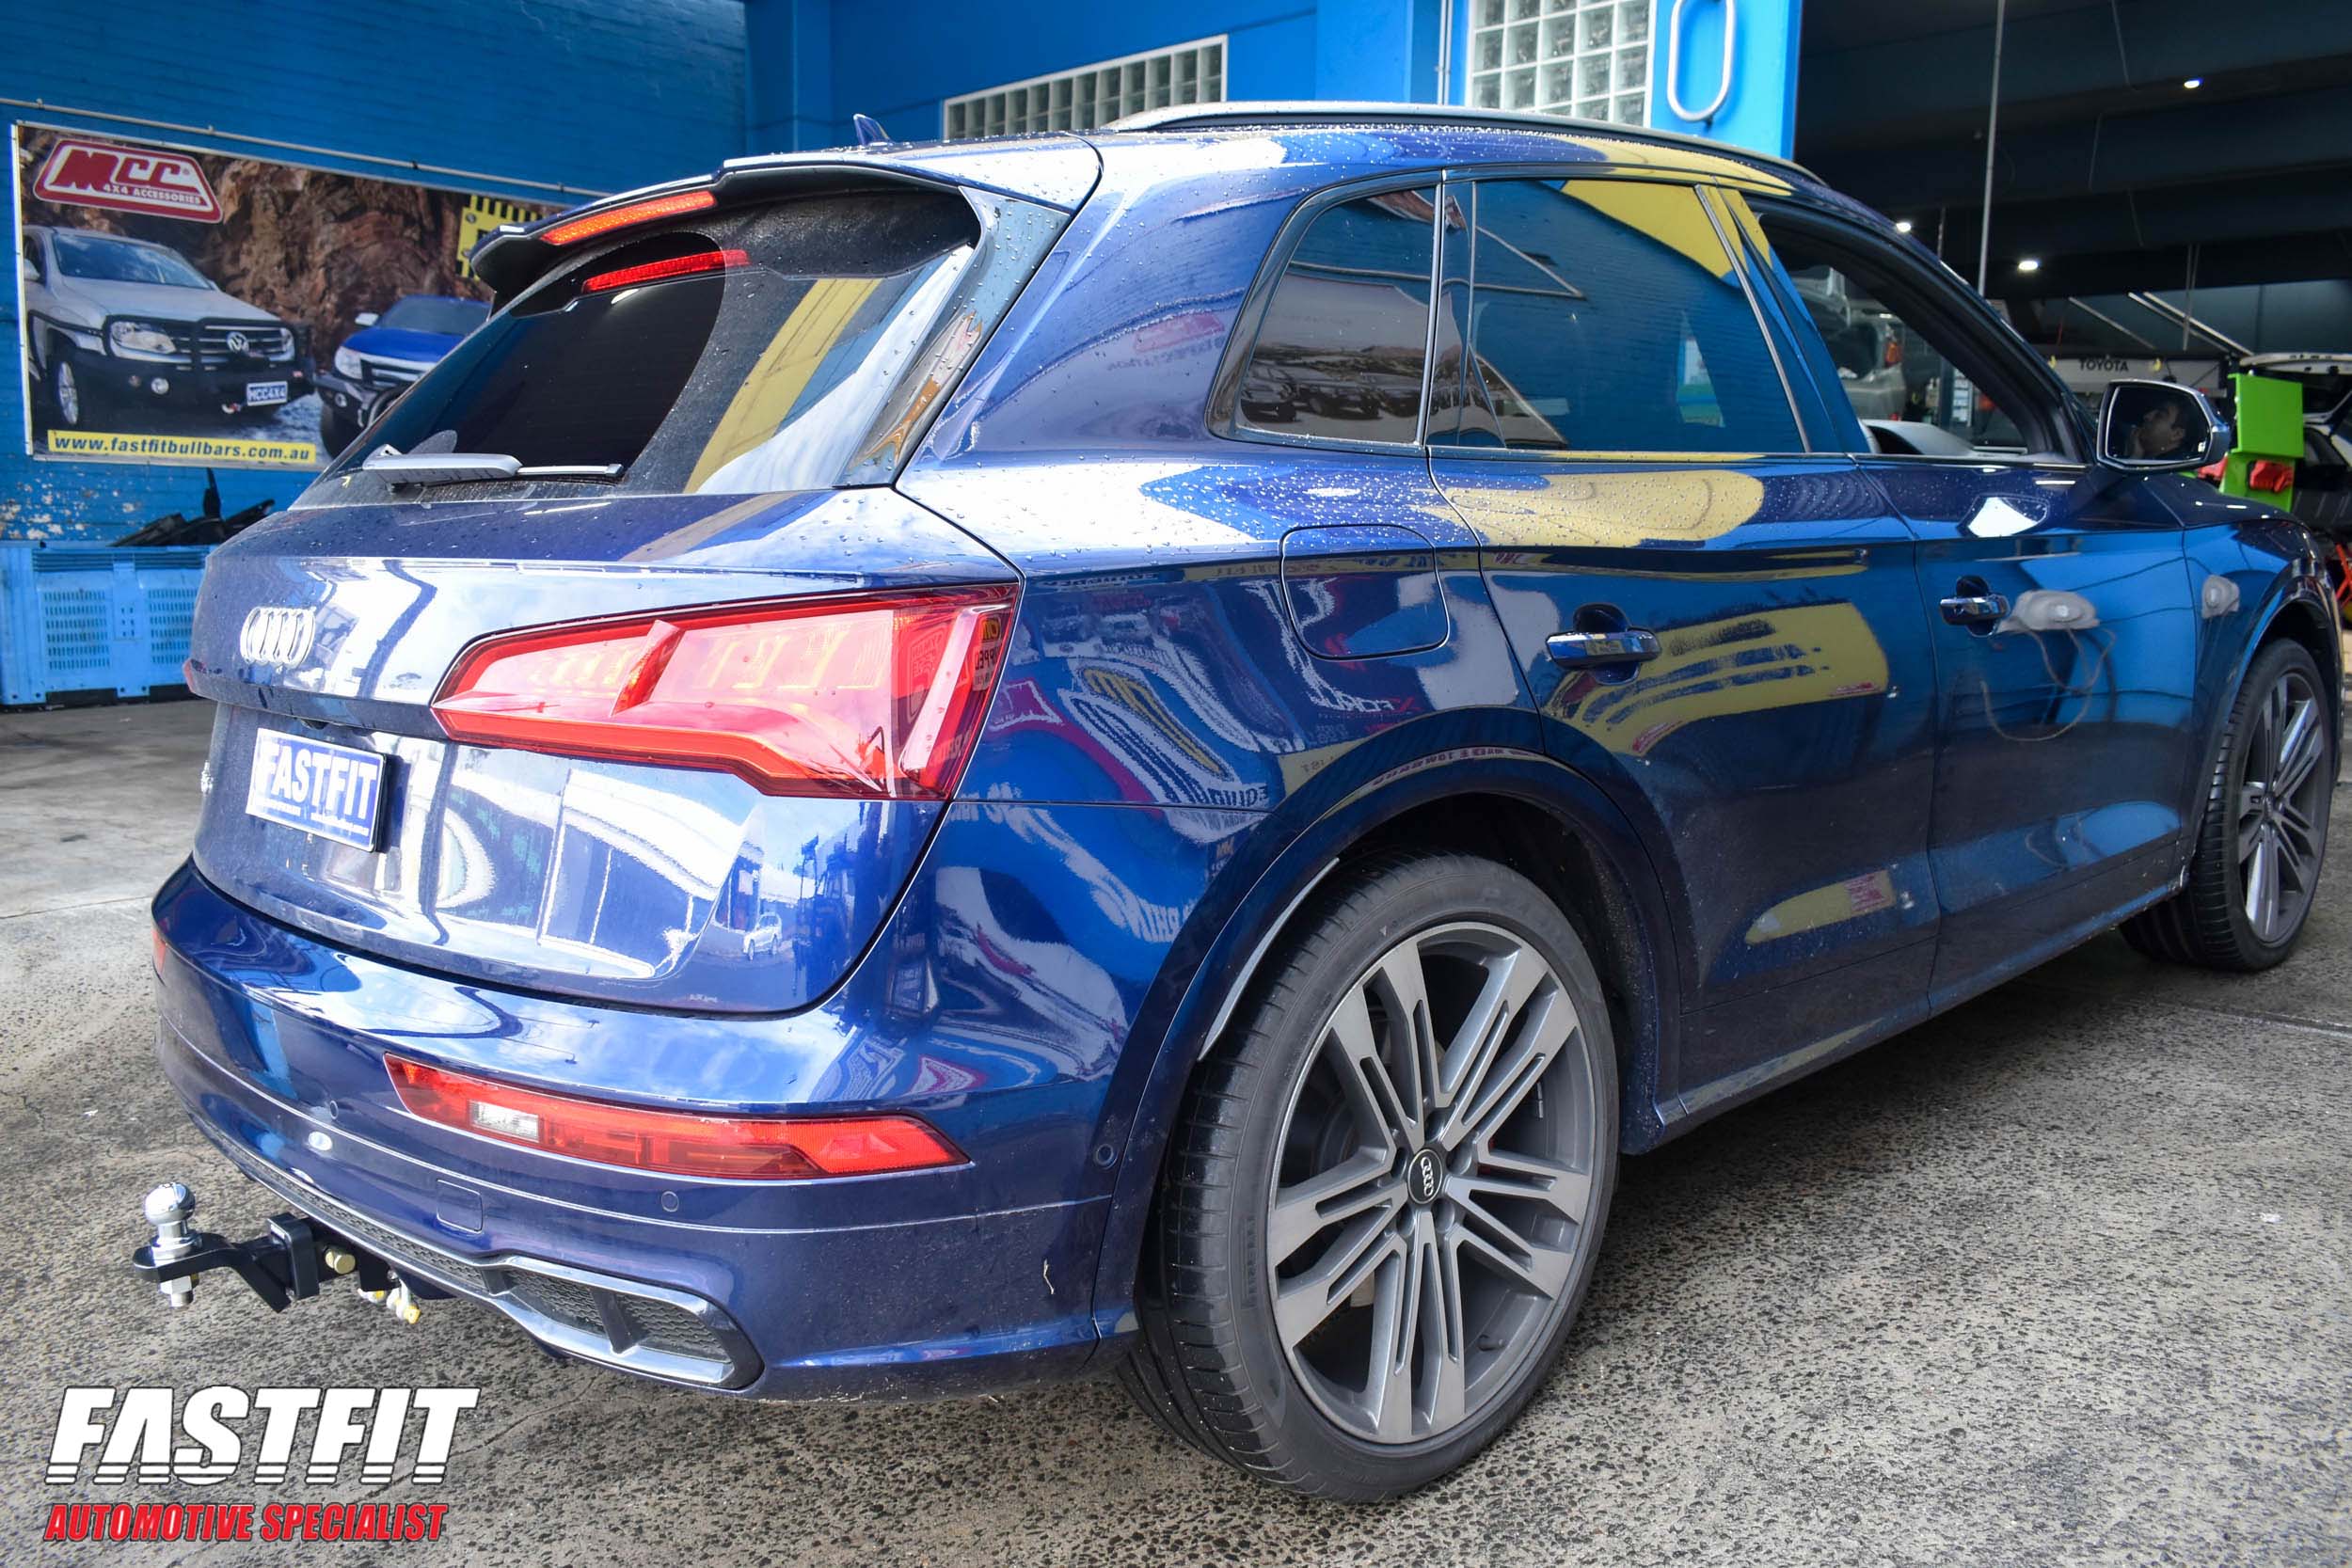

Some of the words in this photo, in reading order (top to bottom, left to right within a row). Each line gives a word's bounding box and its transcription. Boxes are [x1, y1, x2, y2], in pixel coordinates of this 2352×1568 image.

[49, 149, 202, 195] MCC
[103, 183, 129, 196] 4X4
[133, 187, 201, 205] ACCESSORIES
[2078, 357, 2129, 372] TOYOTA
[55, 436, 310, 460] www.fastfitbullbars.com.au
[255, 739, 377, 820] FASTFIT
